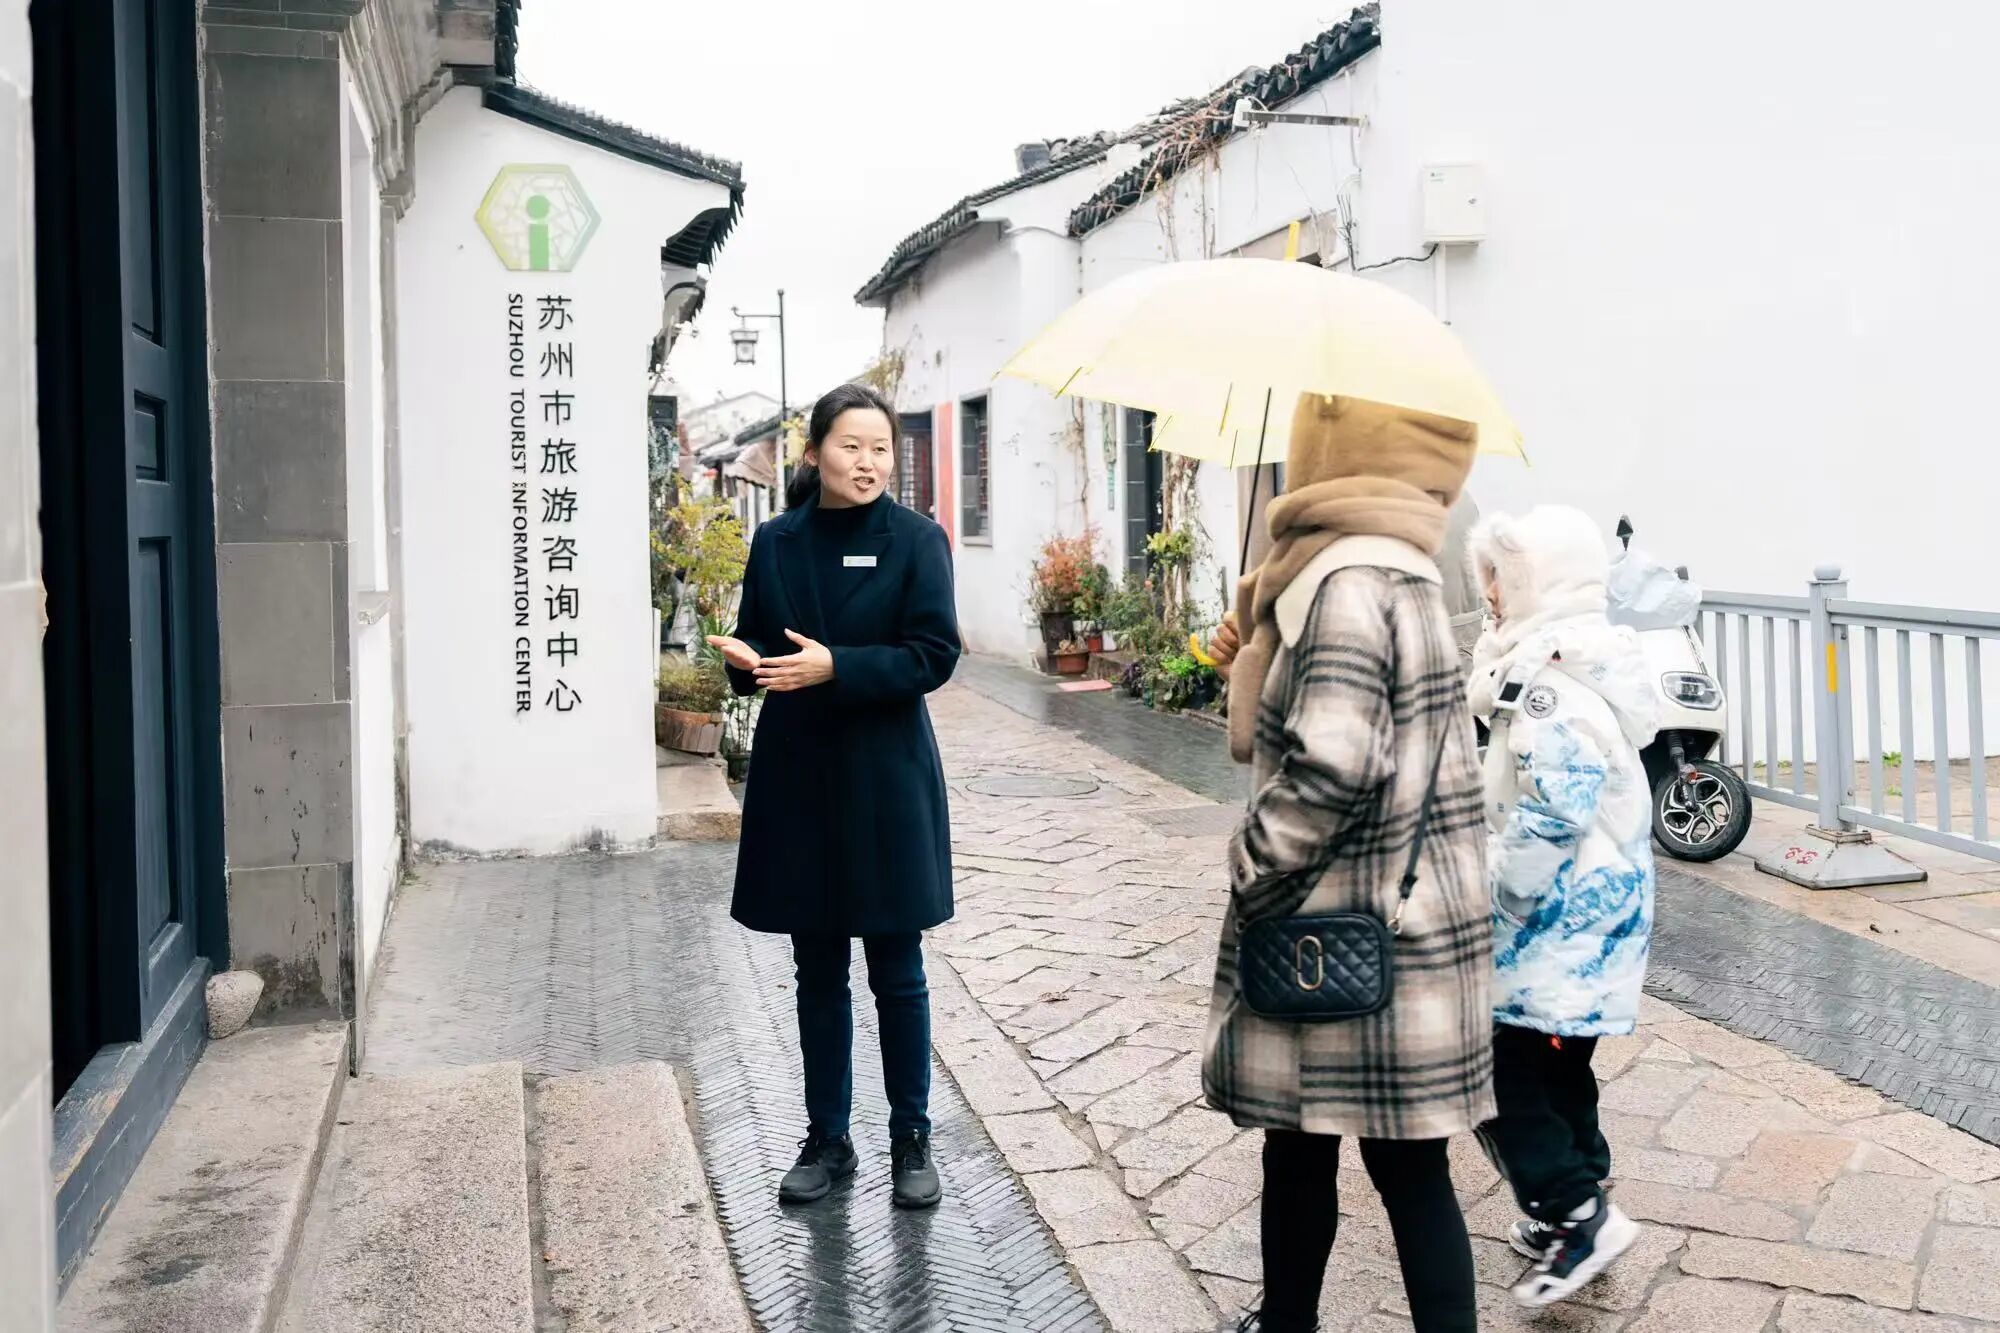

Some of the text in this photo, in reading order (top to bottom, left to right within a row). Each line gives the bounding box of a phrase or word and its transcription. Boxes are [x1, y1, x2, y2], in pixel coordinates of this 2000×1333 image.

[508, 293, 532, 714] SUZHOU TOURIST INFORMATION CENTER
[536, 294, 583, 713] 苏州市旅游咨询中心
